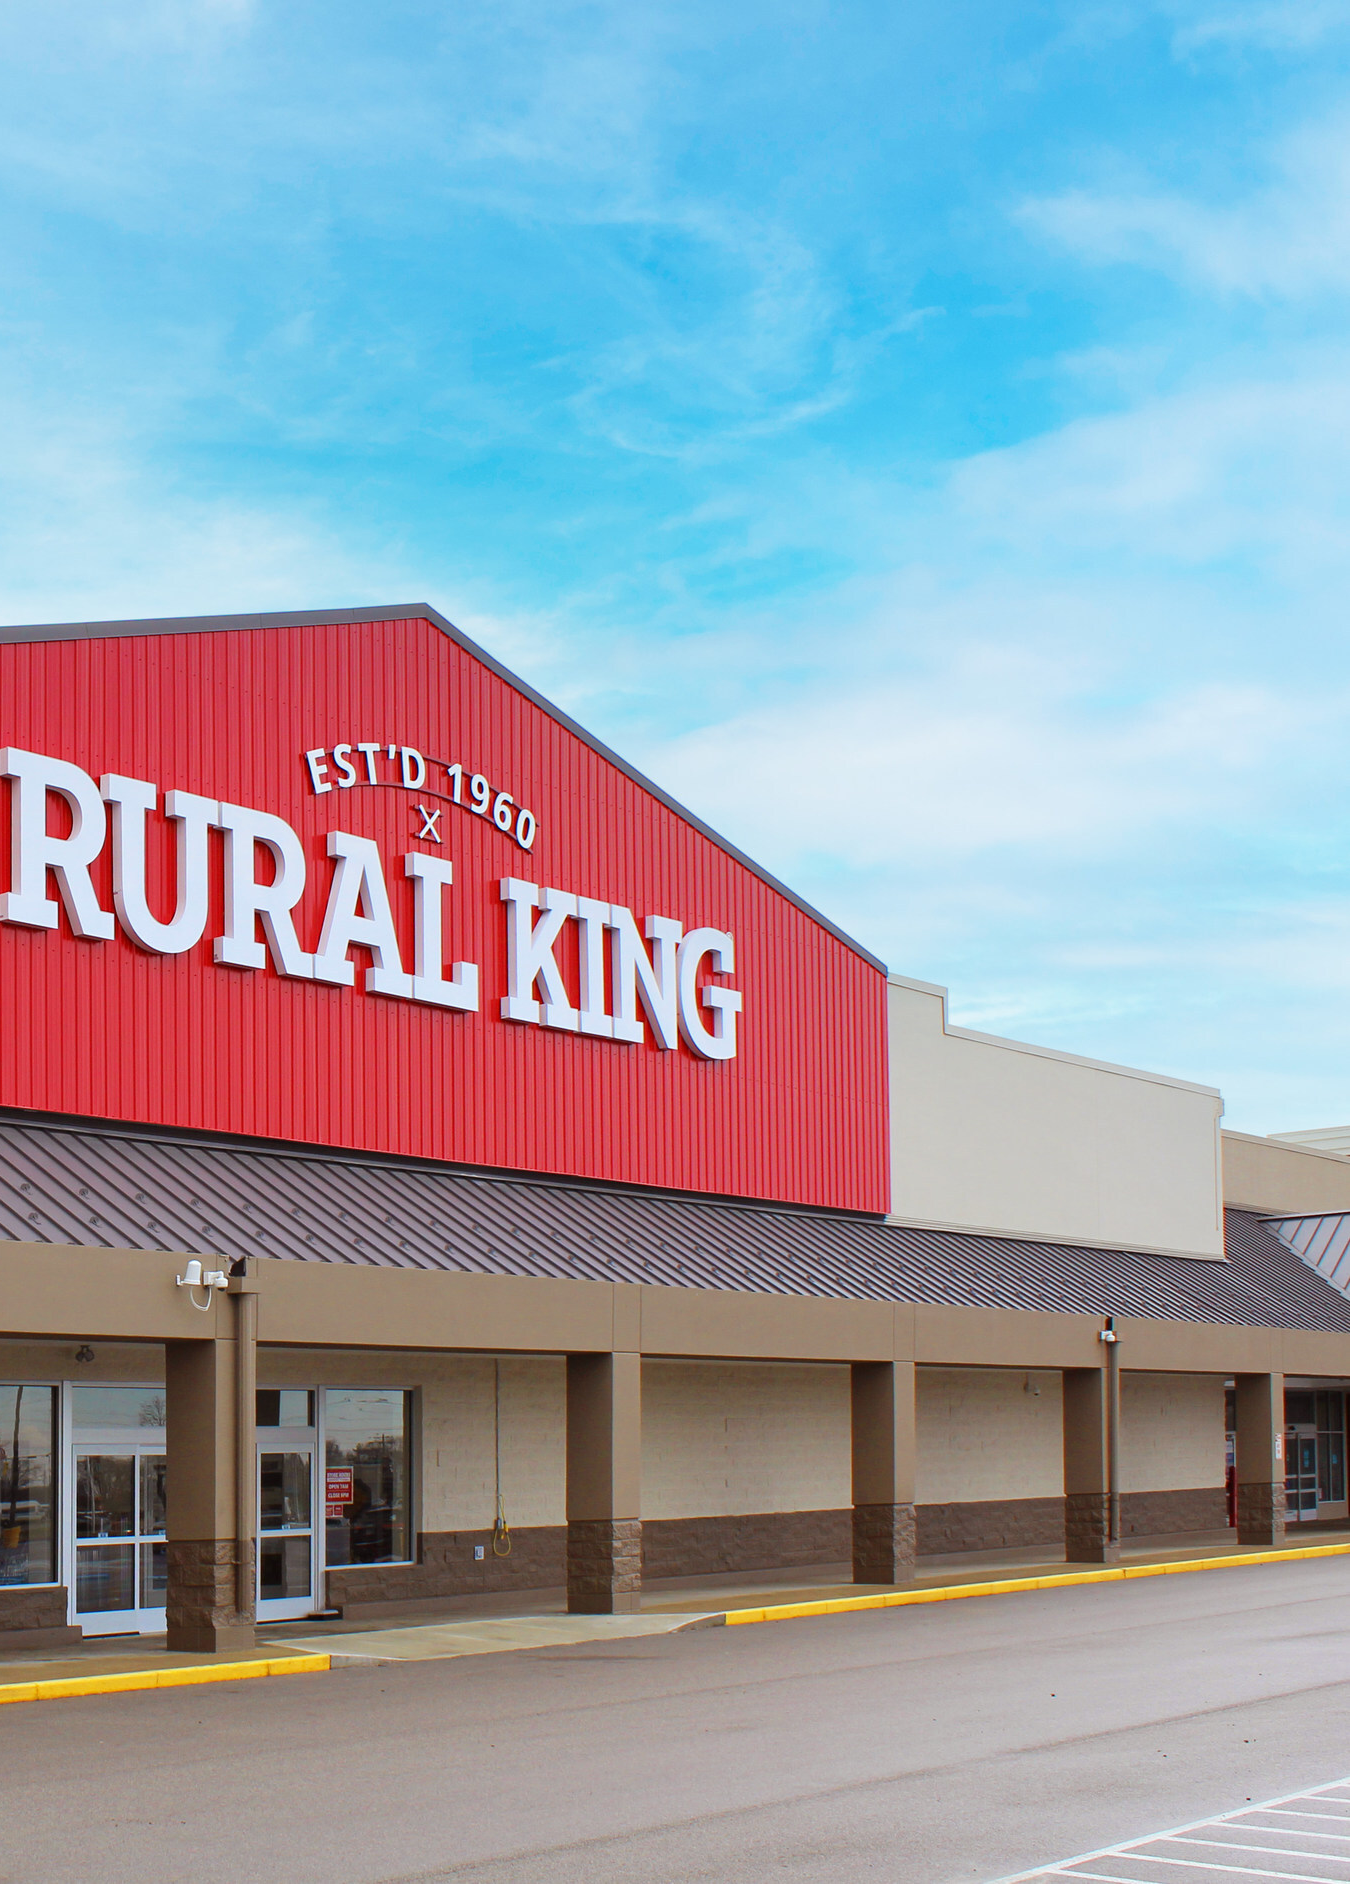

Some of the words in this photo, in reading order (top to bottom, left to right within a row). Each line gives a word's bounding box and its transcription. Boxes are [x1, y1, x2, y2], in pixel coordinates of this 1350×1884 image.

[305, 742, 426, 795] EST'D
[447, 763, 536, 850] 1960
[500, 876, 742, 1061] KING
